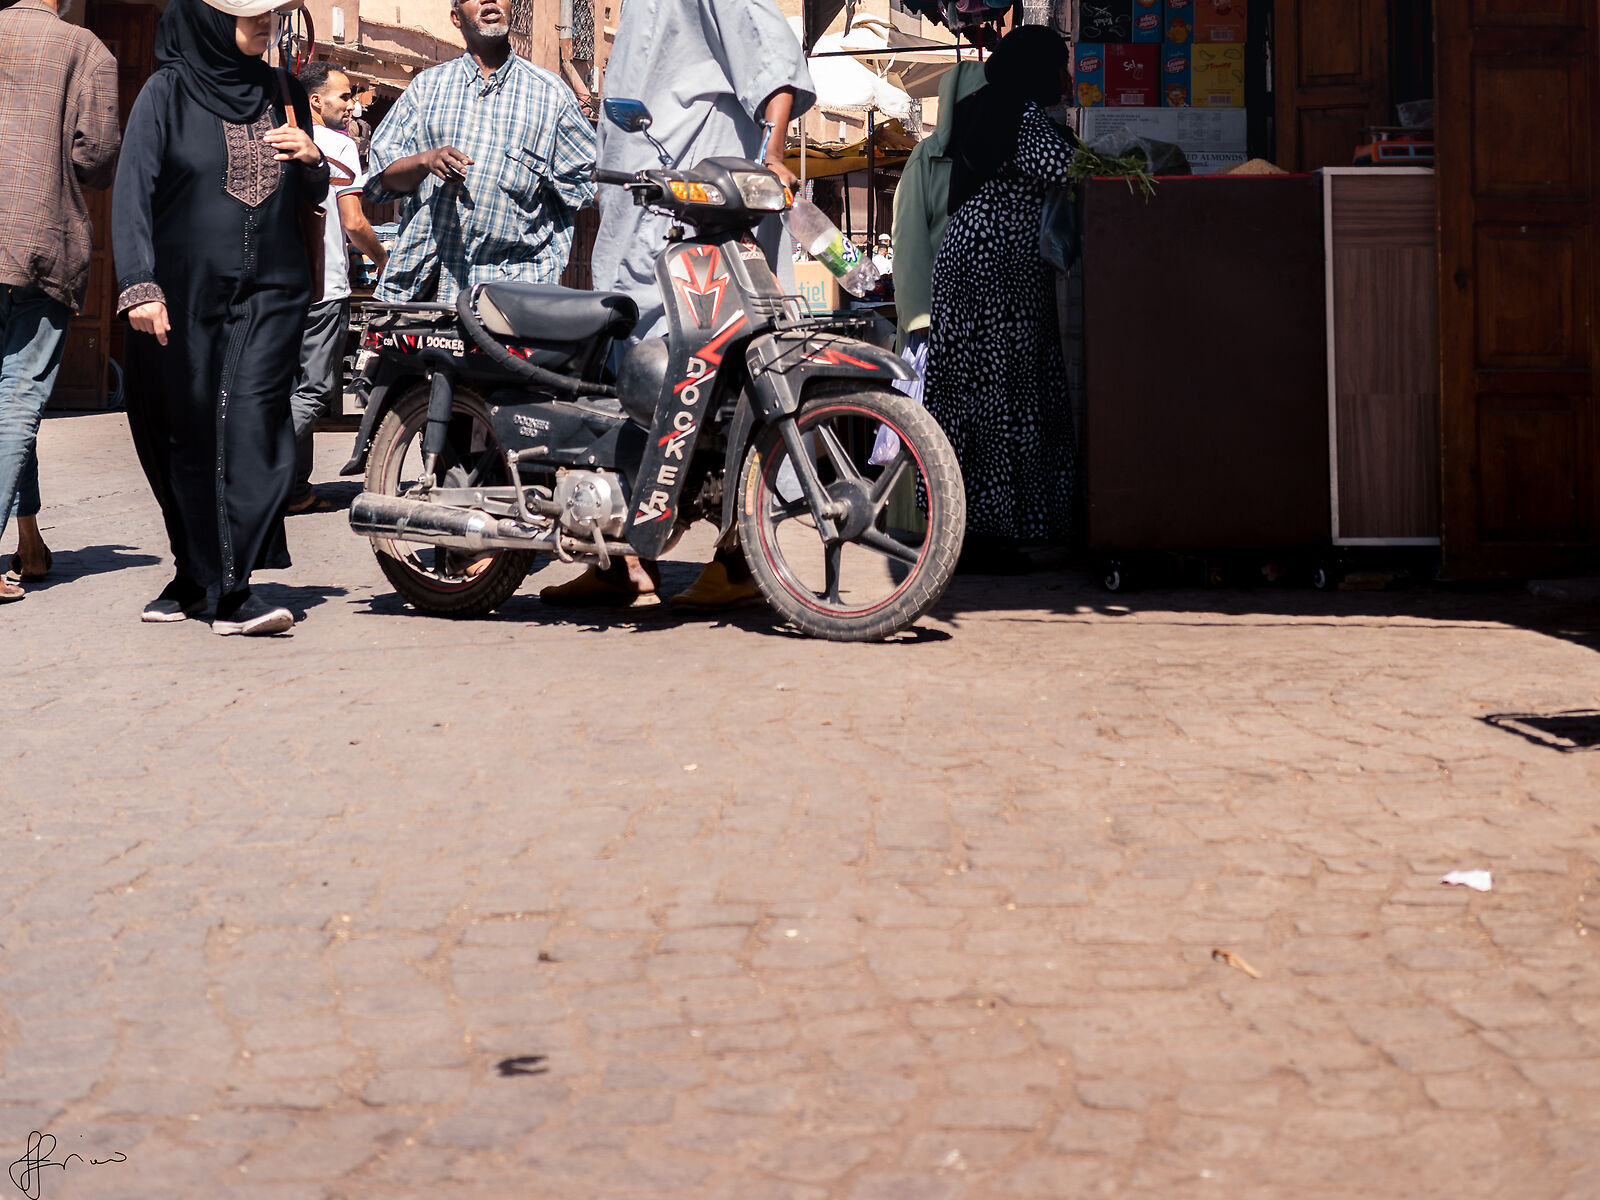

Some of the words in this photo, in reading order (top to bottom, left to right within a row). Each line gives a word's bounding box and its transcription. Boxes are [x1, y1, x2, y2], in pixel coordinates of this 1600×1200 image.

[426, 336, 465, 351] DOCKER
[513, 414, 550, 431] DOCKER
[648, 356, 707, 513] DOCKER
